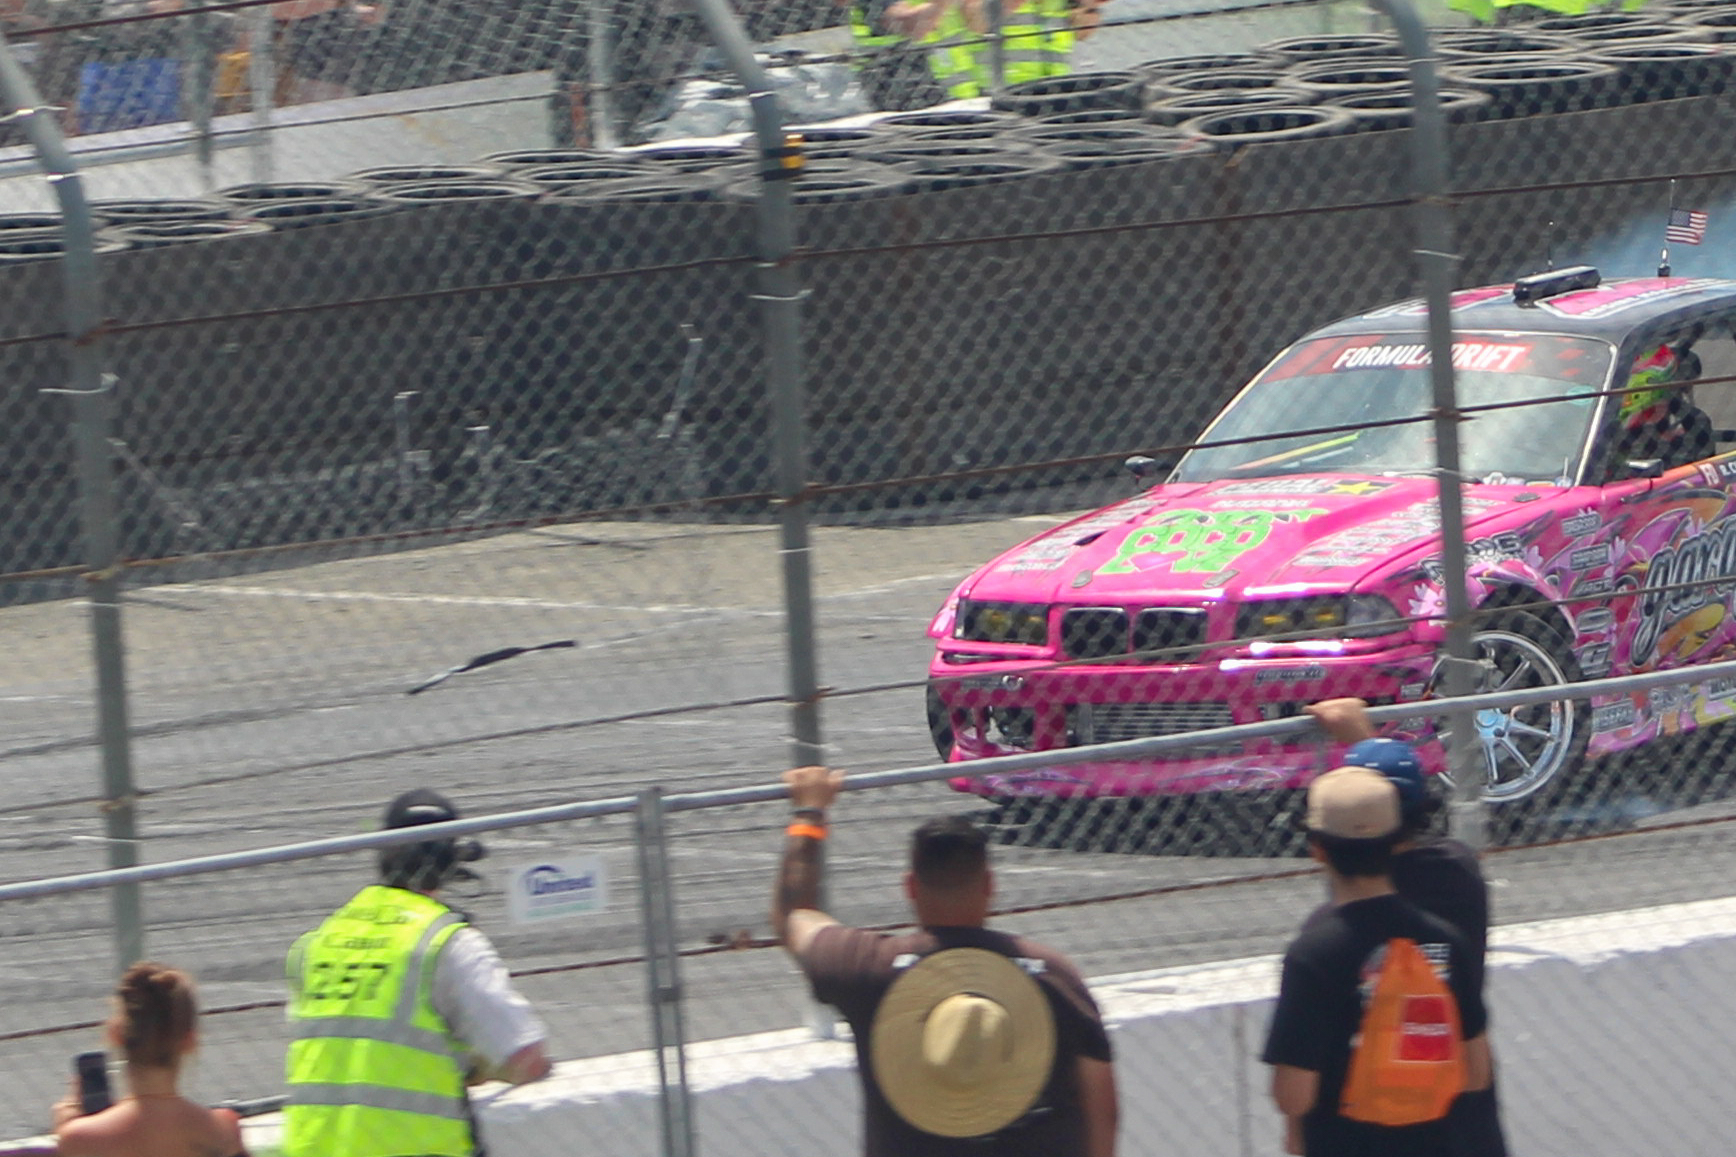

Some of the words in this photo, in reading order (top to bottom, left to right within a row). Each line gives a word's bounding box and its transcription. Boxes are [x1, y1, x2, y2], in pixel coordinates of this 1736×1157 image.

[1332, 344, 1433, 370] FORMULA
[1451, 344, 1527, 370] DRIFT
[1118, 524, 1272, 555] COCO
